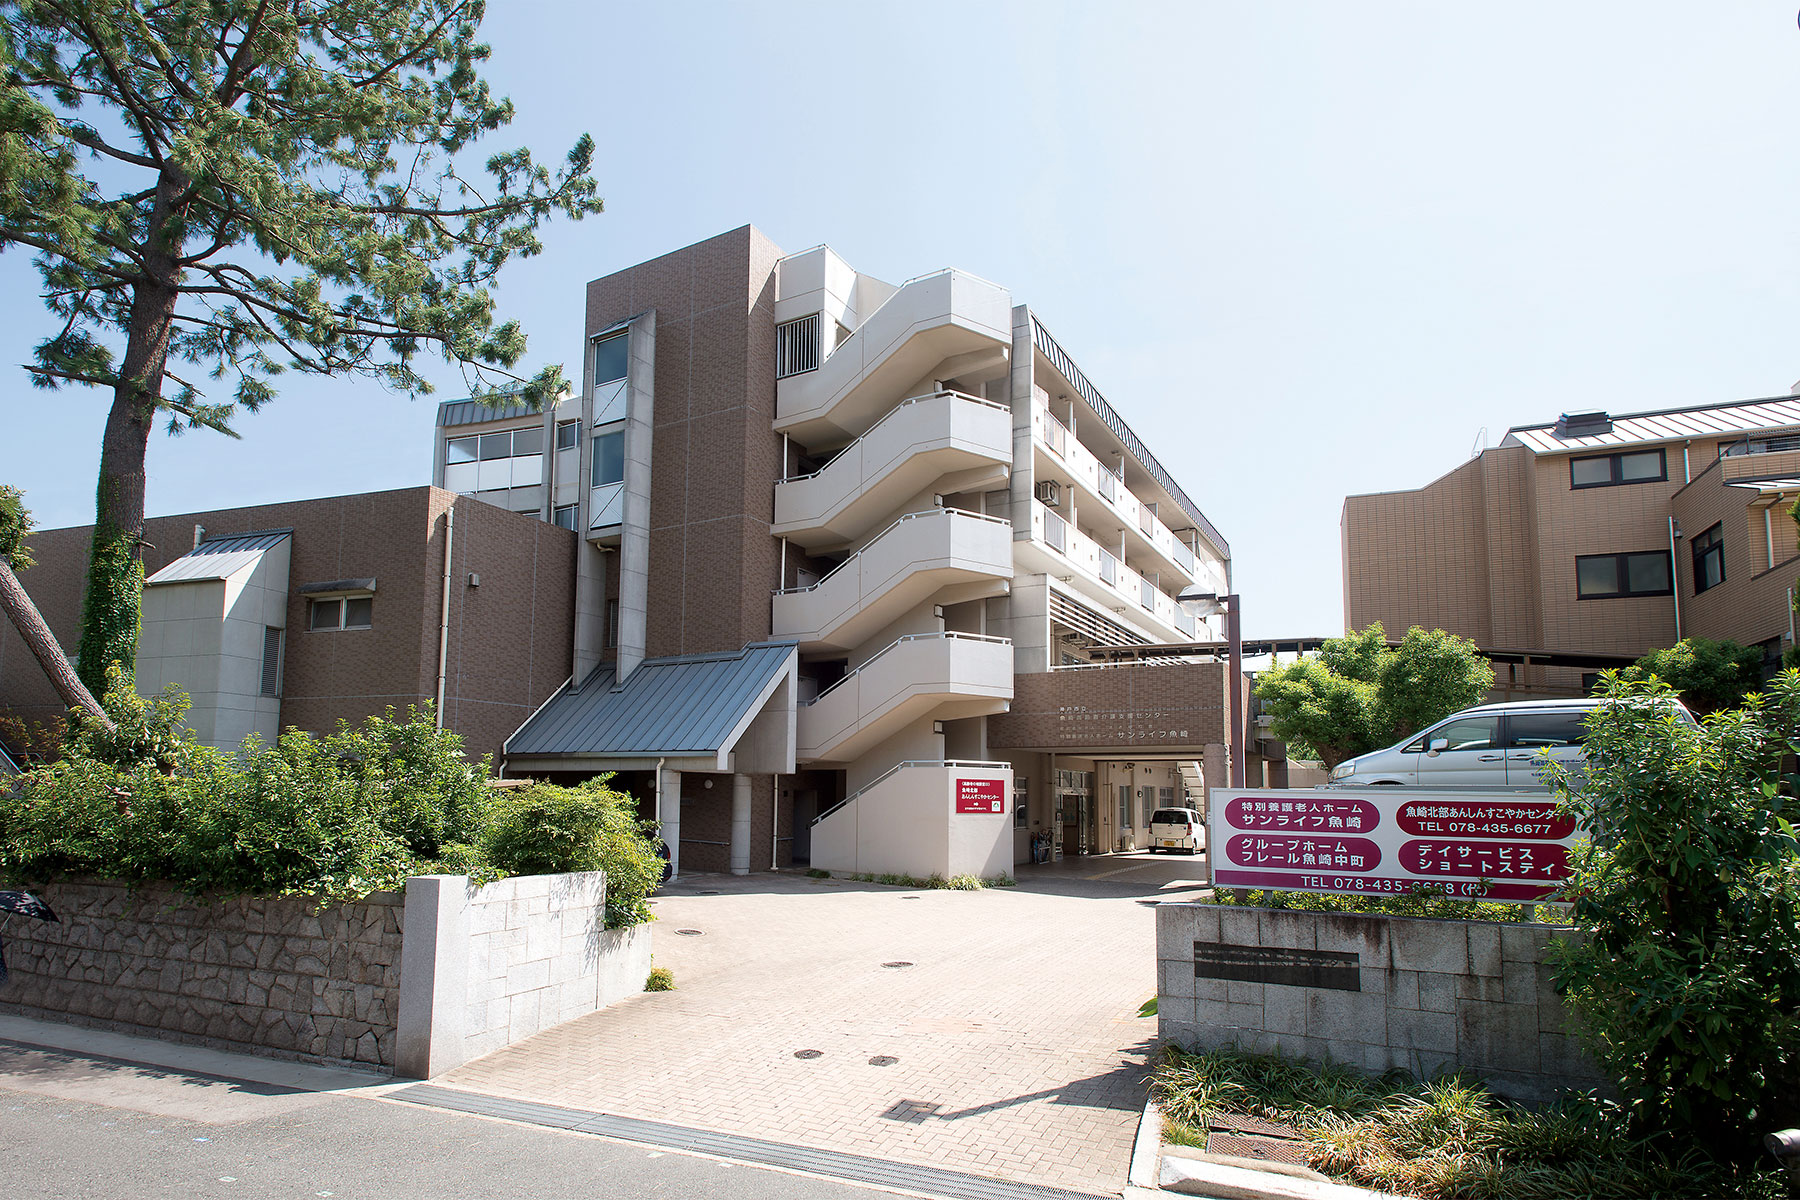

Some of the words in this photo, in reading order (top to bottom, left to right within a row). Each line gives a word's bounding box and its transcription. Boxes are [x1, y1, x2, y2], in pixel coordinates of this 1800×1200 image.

[1118, 730, 1188, 739] サンライフ魚崎
[1241, 801, 1363, 813] 特別養護老人ホーム
[1242, 814, 1362, 829] サンライフ魚崎
[1418, 821, 1444, 832] TEL
[1449, 822, 1552, 834] 078-435-6677
[1241, 838, 1348, 853] グループホーム
[1418, 844, 1534, 860] デイサービス
[1241, 851, 1365, 867] フレール魚崎中町
[1418, 858, 1556, 875] ショートステイ
[1300, 875, 1329, 888] TEL
